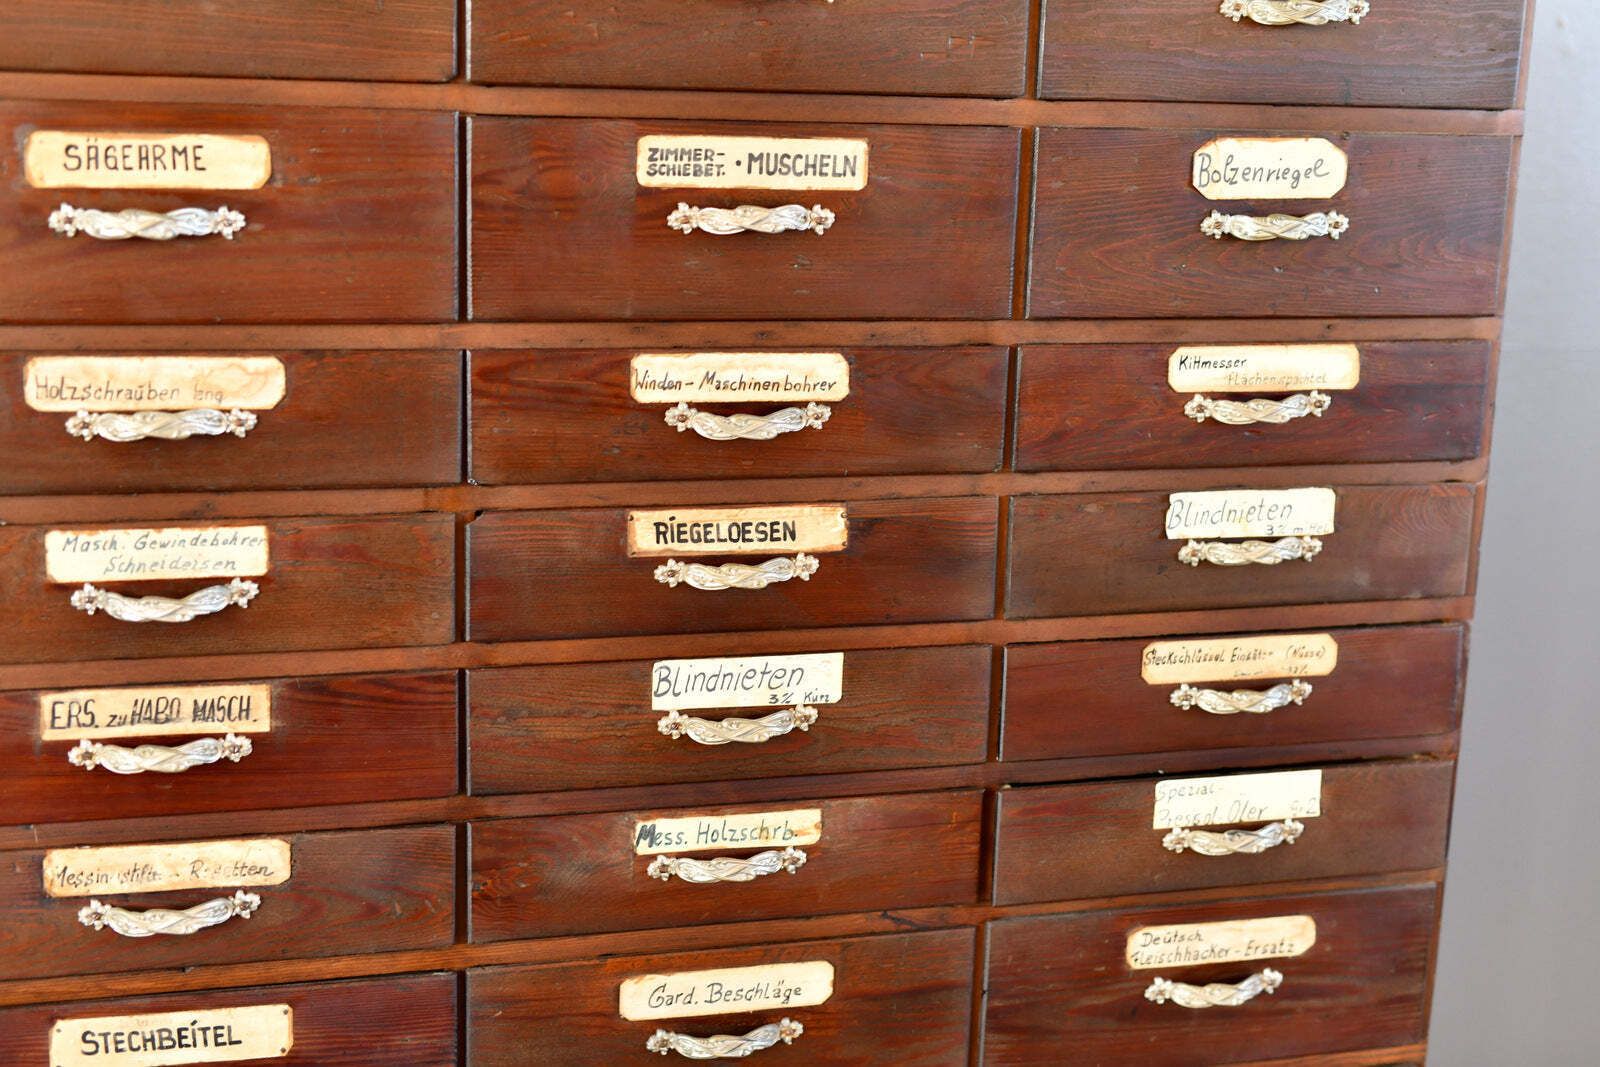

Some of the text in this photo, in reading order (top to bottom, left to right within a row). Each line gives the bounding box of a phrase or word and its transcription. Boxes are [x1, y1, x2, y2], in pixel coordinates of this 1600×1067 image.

[63, 139, 207, 172] SÄGEARME
[646, 147, 726, 162] ZIMMER-
[646, 163, 726, 177] SCHIEBET.
[746, 151, 858, 178] MUSCHELN
[1197, 152, 1330, 190] Bolzenriegel
[1168, 497, 1293, 532] Blindnieten
[104, 554, 237, 576] Schneideisen
[653, 661, 805, 698] Blindnieten
[50, 698, 100, 730] ERS.
[106, 713, 128, 728] zu
[191, 694, 259, 723] MASCH.
[635, 818, 799, 848] Mess. Holzschrb.
[647, 978, 803, 1009] Gard. Beschläge
